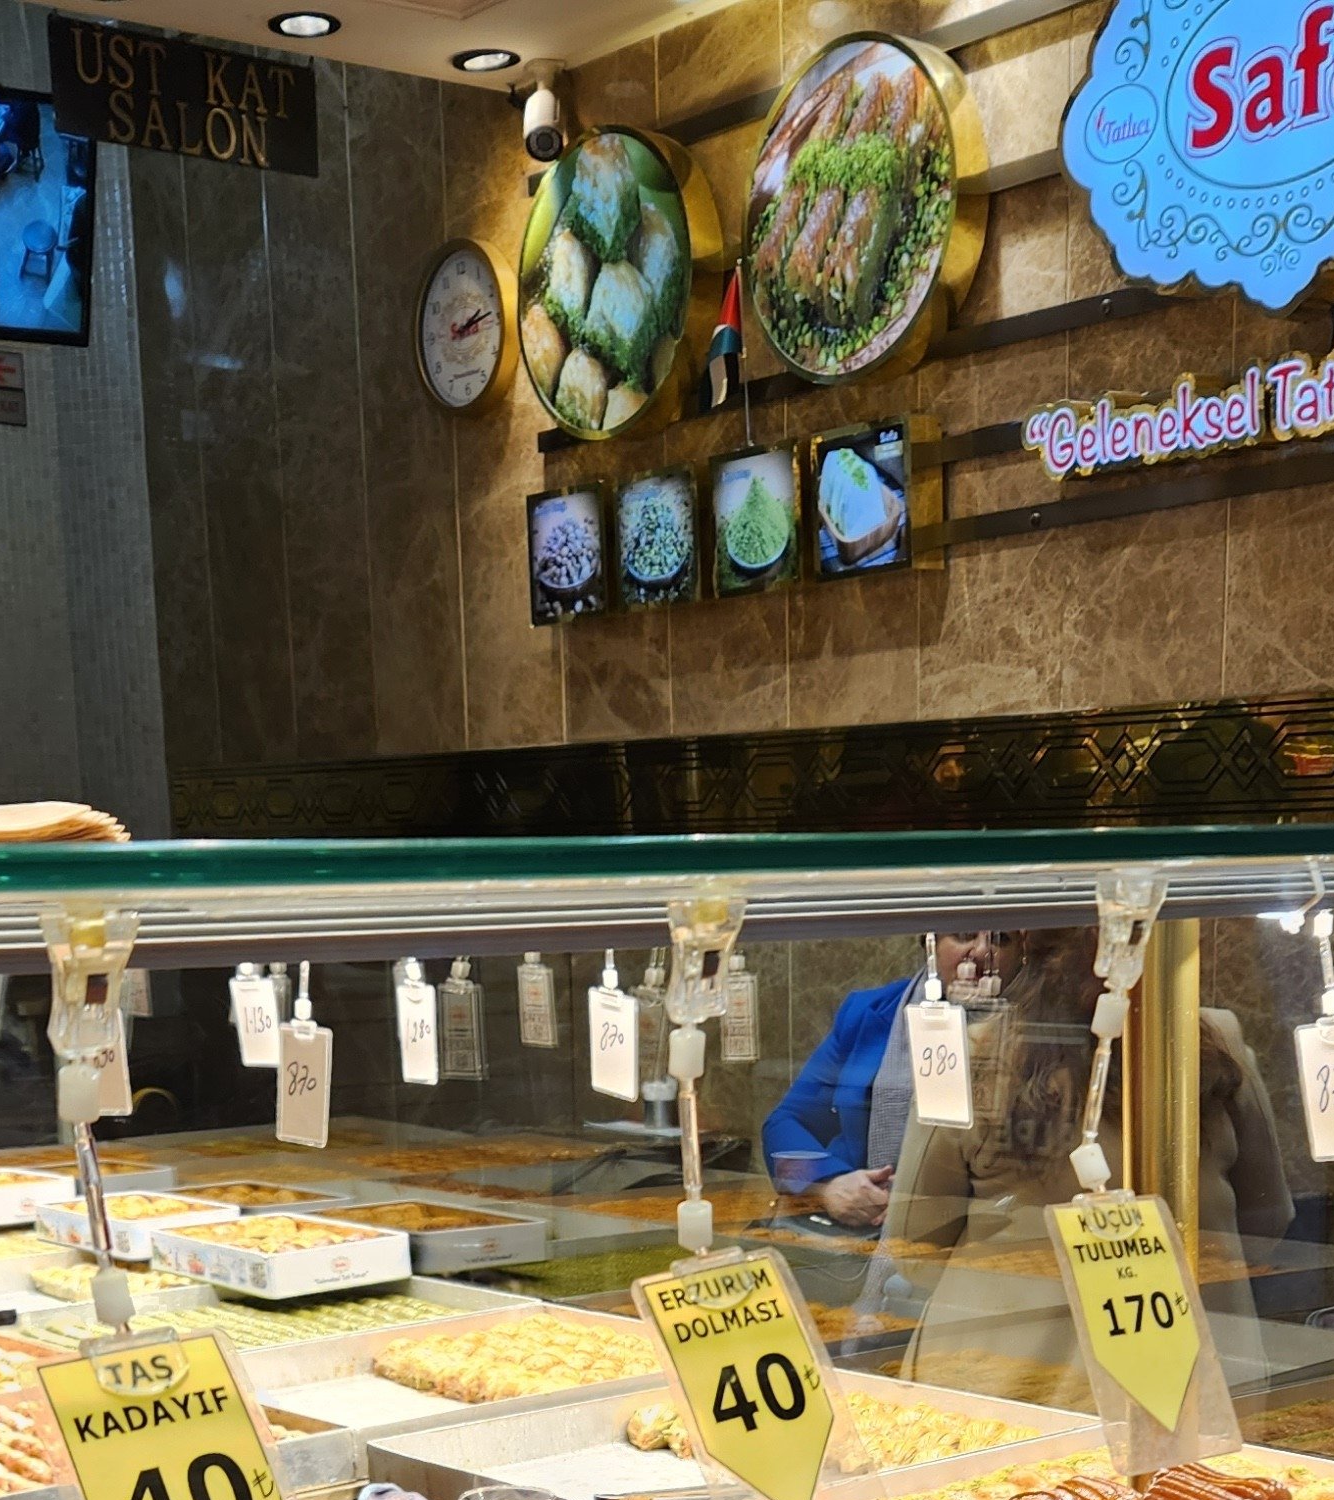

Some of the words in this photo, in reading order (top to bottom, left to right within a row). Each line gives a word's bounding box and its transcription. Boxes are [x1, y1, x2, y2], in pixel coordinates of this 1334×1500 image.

[204, 50, 297, 120] KAT
[107, 89, 268, 168] SALON
[1028, 365, 1261, 471] “Geleneksel
[600, 1021, 625, 1051] 870
[286, 1061, 318, 1096] 870
[919, 1044, 958, 1077] 980
[1073, 1236, 1167, 1263] TULUMBA
[657, 1268, 772, 1313] ERZURUM
[673, 1298, 784, 1344] DOLMASI
[73, 1386, 229, 1443] KADAYIF
